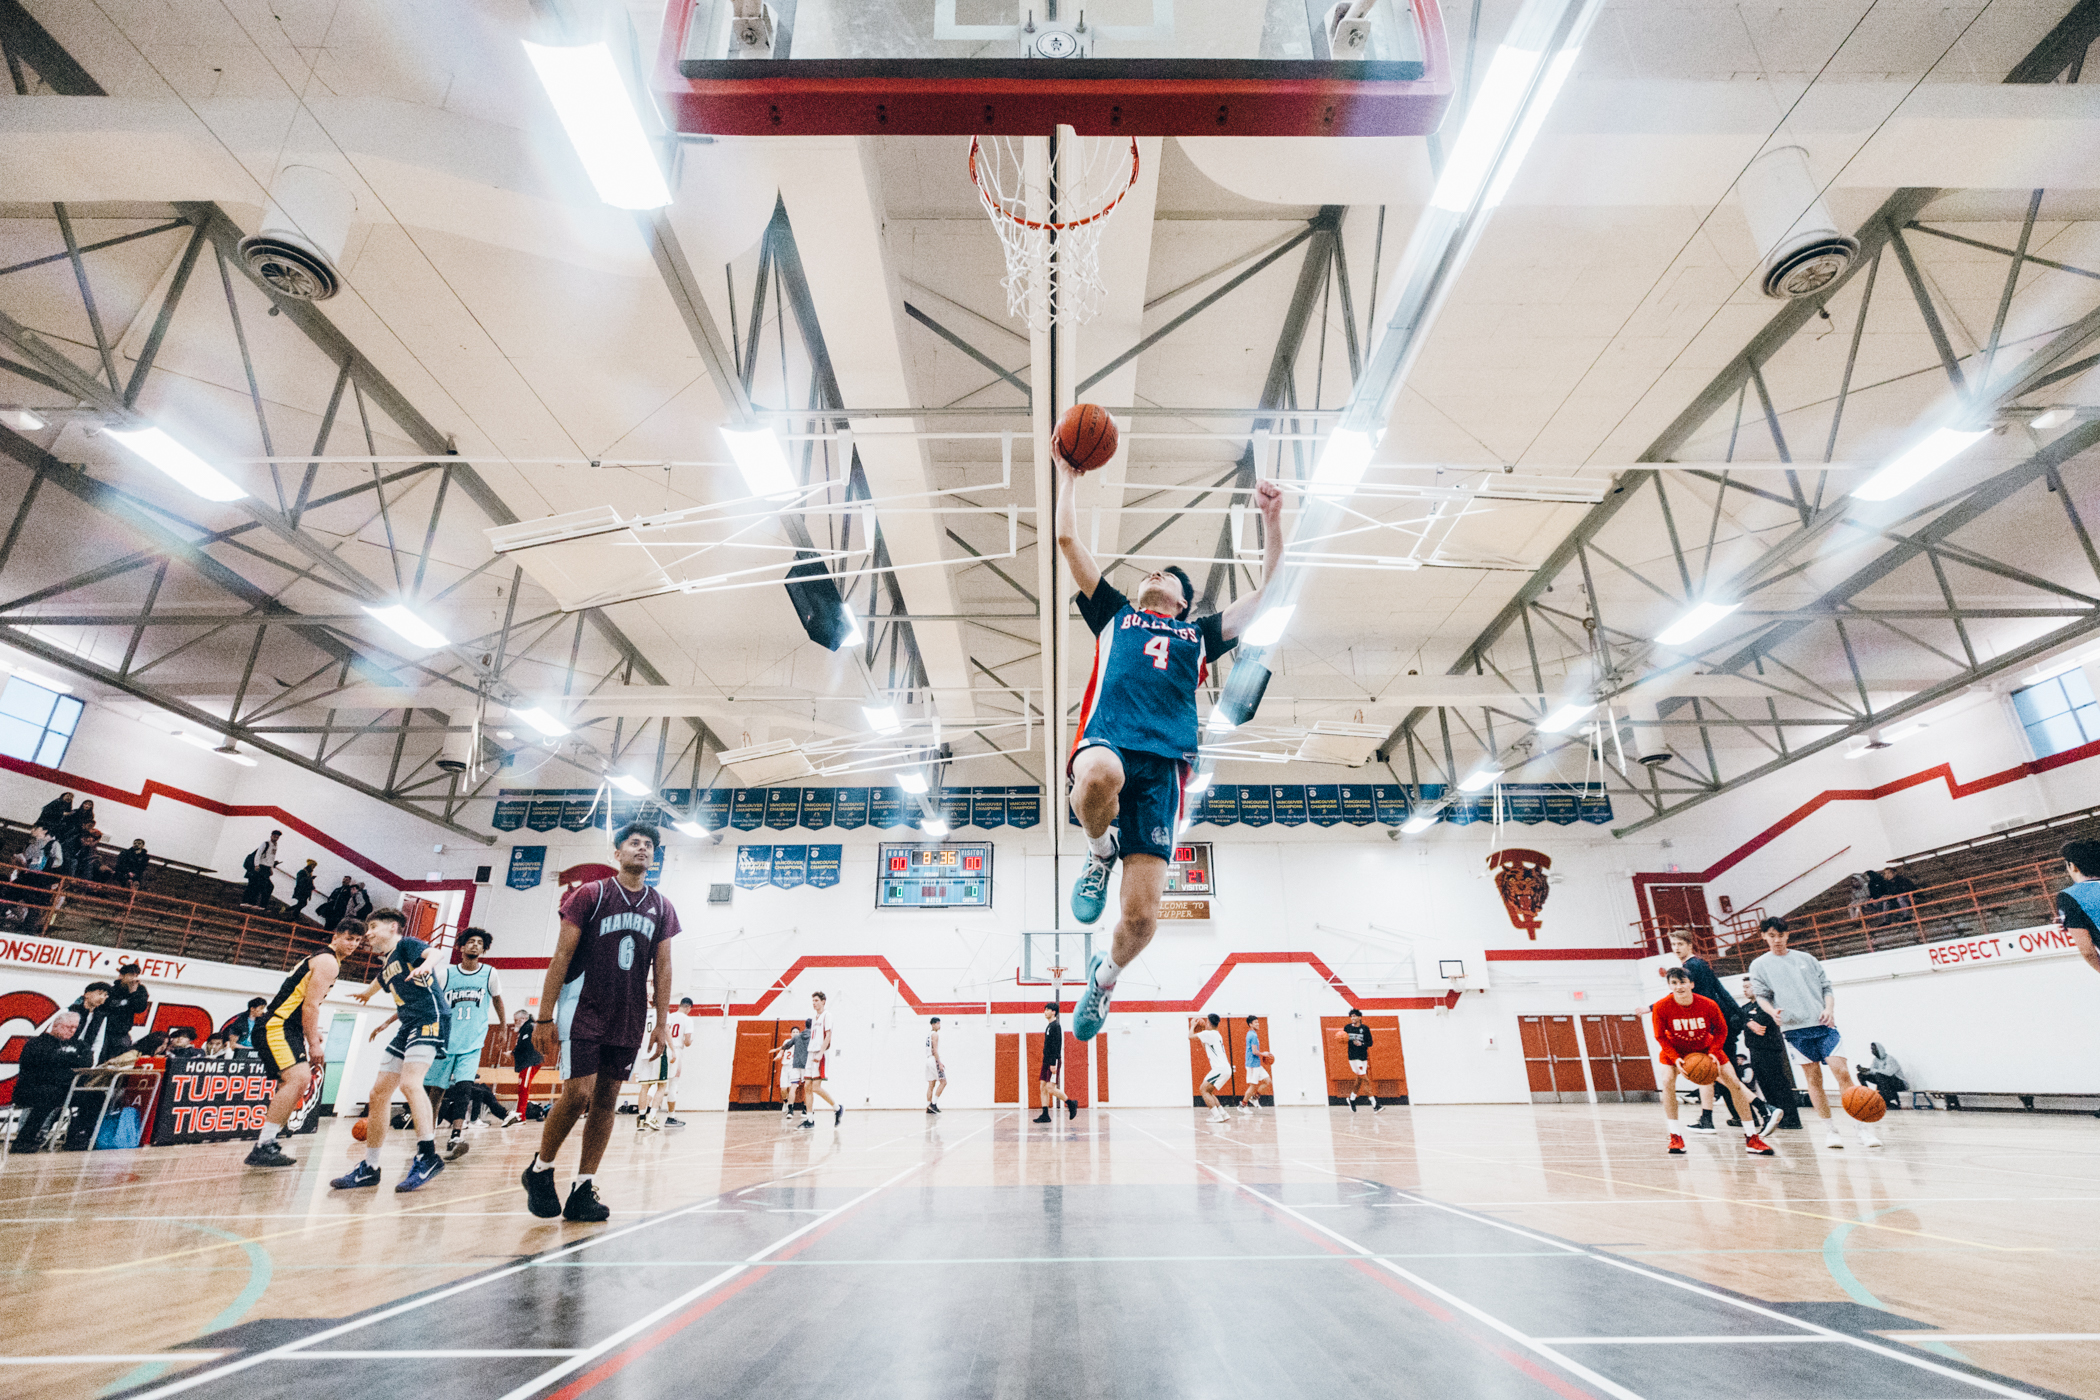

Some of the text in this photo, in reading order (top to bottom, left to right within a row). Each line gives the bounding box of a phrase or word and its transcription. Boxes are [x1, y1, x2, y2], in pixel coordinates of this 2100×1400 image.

[1120, 614, 1198, 643] BULLGS
[1143, 636, 1170, 670] 4
[891, 857, 907, 871] 00
[966, 857, 982, 870] 00
[1188, 870, 1205, 883] 27
[897, 886, 903, 897] 0
[972, 886, 978, 897] 0
[618, 935, 635, 970] 6
[1929, 939, 2001, 965] RESPECT
[116, 955, 186, 979] SFETY
[444, 988, 486, 1006] DRAGONS
[457, 1007, 471, 1020] 11
[1673, 1017, 1706, 1030] BYNG
[186, 1062, 266, 1073] HOME OF TH
[172, 1075, 278, 1102] TUPPER
[172, 1104, 267, 1134] TIGERS
